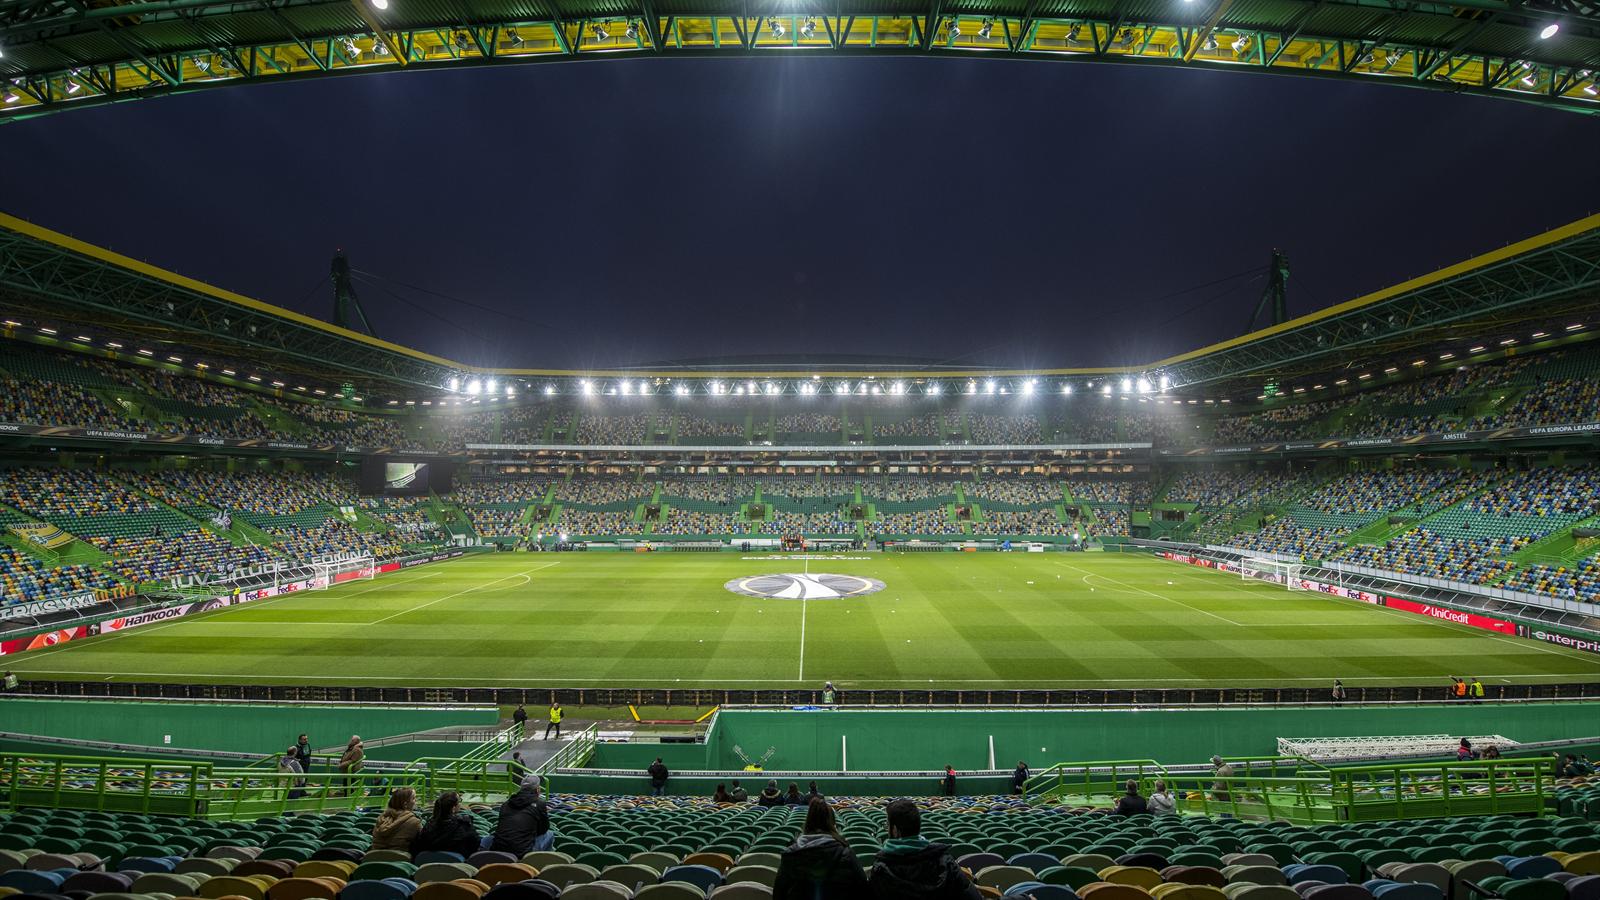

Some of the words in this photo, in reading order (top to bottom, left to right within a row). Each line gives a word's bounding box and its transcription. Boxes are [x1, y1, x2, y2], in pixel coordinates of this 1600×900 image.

[1547, 425, 1572, 433] EUROPA
[1573, 423, 1600, 431] LEAGUE
[1443, 432, 1467, 440] AMSTEL
[245, 588, 269, 601] FedEx
[277, 583, 299, 595] FedEx
[1318, 583, 1339, 596] FedEx
[1347, 589, 1370, 602] FedEx
[1431, 606, 1469, 625] UniCredit
